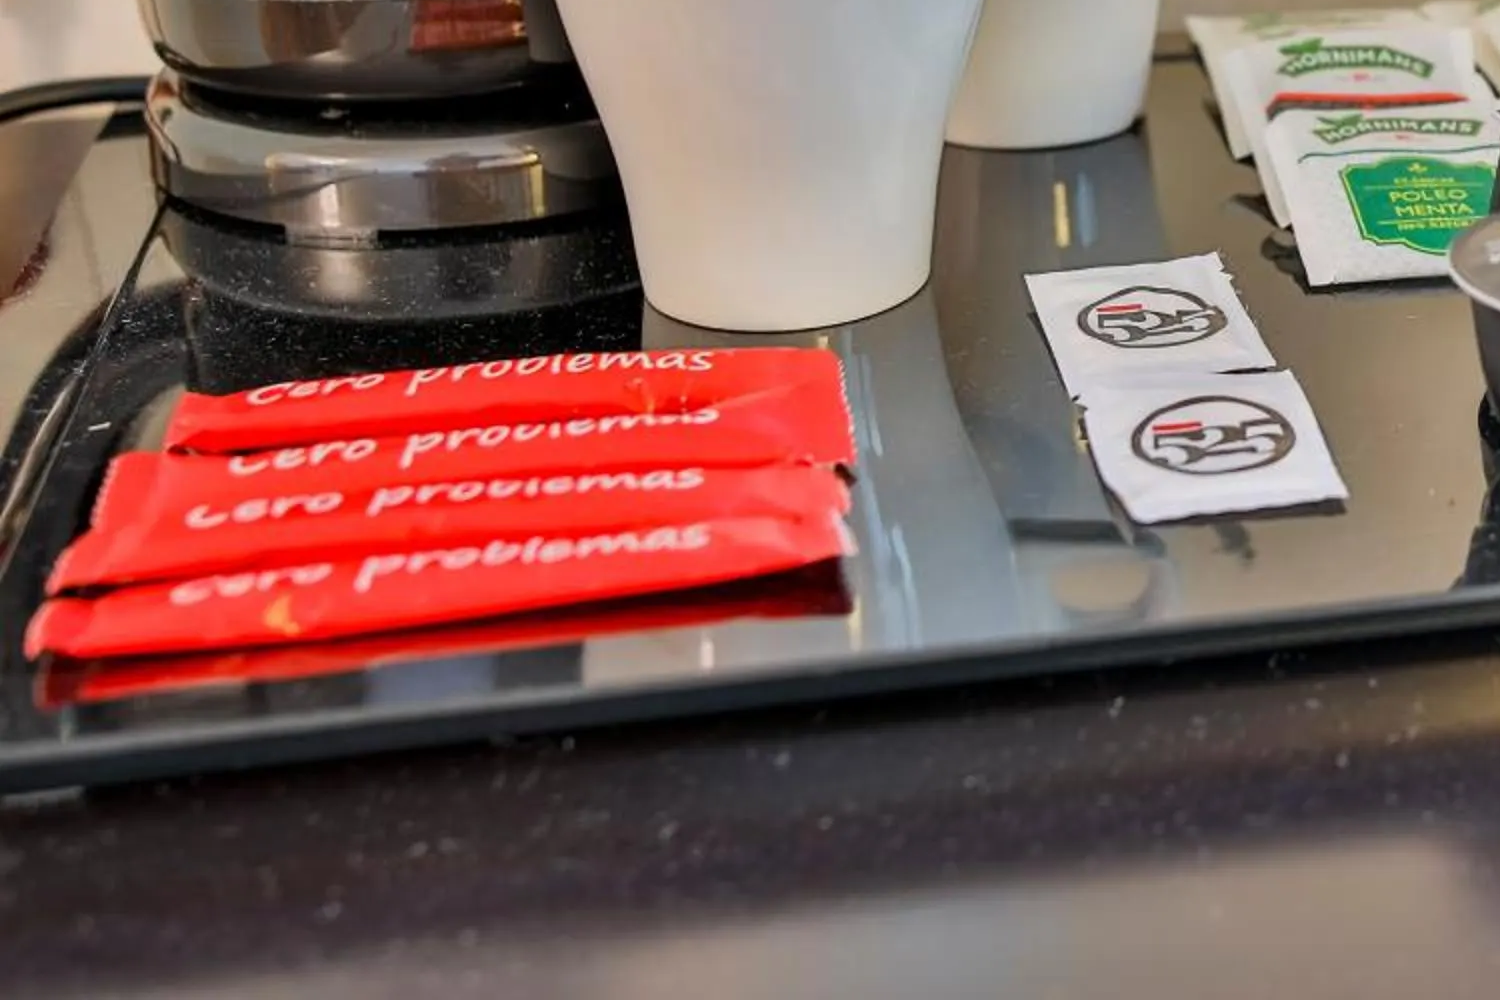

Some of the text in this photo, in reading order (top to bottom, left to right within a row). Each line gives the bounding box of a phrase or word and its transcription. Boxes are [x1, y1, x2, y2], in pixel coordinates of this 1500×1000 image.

[1286, 49, 1427, 77] HORNIMANS
[1324, 119, 1475, 142] HORNIMANS
[1389, 188, 1468, 203] POLEO
[1395, 202, 1474, 217] MENTA
[245, 351, 714, 406] Cero problemas
[184, 491, 344, 530] Cero
[169, 523, 712, 605] Cero problemas
